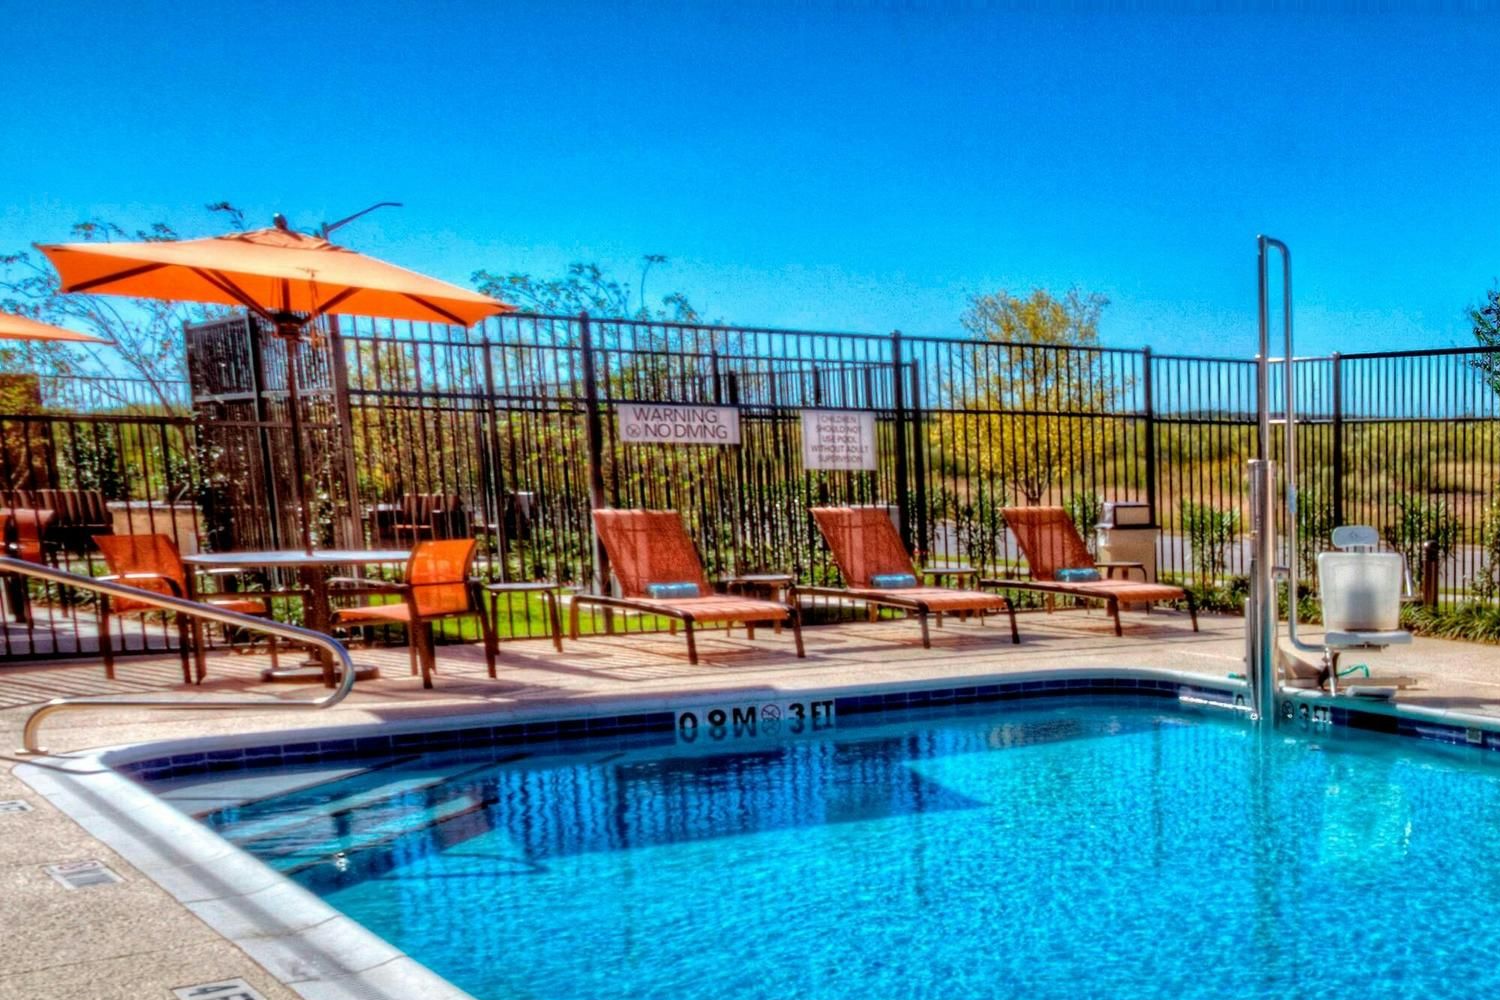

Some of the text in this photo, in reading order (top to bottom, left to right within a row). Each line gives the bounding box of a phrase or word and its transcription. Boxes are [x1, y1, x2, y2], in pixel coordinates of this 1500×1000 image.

[632, 407, 718, 423] WARNING
[644, 423, 728, 439] NO DIVING
[188, 985, 241, 998] 4
